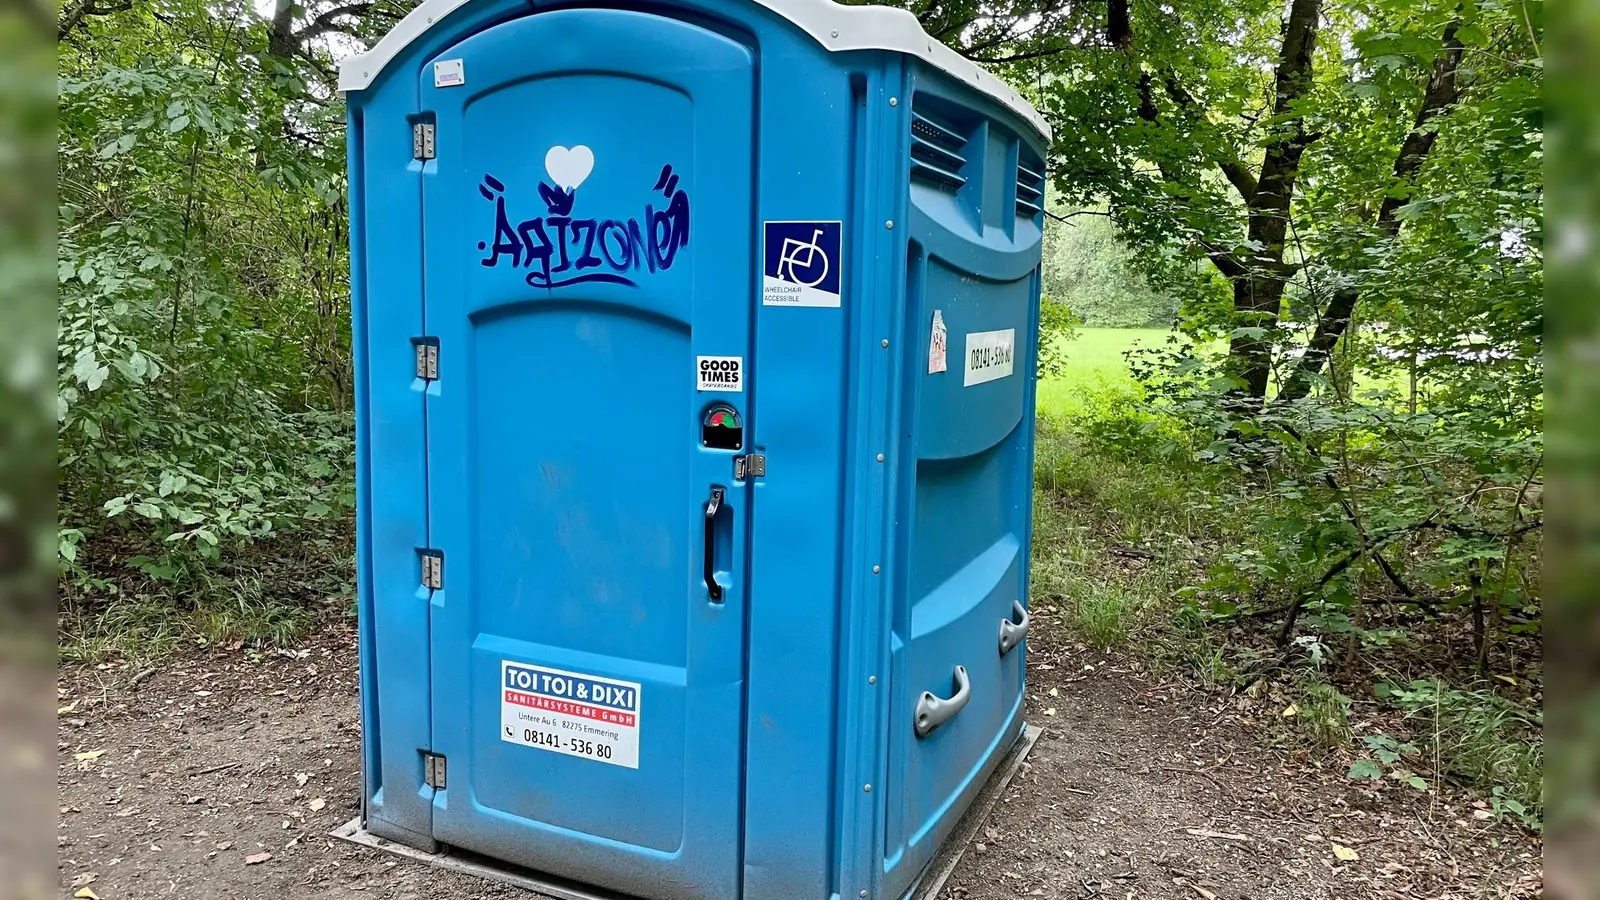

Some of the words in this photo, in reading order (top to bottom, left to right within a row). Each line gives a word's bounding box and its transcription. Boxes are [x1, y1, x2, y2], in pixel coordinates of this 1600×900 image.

[700, 360, 739, 371] GOOD
[970, 347, 990, 370] 08141
[700, 371, 739, 382] TIMES
[508, 669, 538, 690] TOI
[542, 675, 573, 697] TOI
[576, 683, 589, 700] &
[592, 684, 633, 708] DIXI
[507, 692, 597, 717] SANITÄRSYSTEME
[602, 711, 633, 725] GmbH
[518, 712, 541, 724] Untere
[542, 716, 551, 725] Au
[552, 718, 557, 727] 6
[562, 720, 583, 732] 82275
[584, 725, 619, 741] Emmering
[524, 728, 560, 748] 08141
[571, 738, 593, 756] 536
[597, 744, 612, 759] 80
